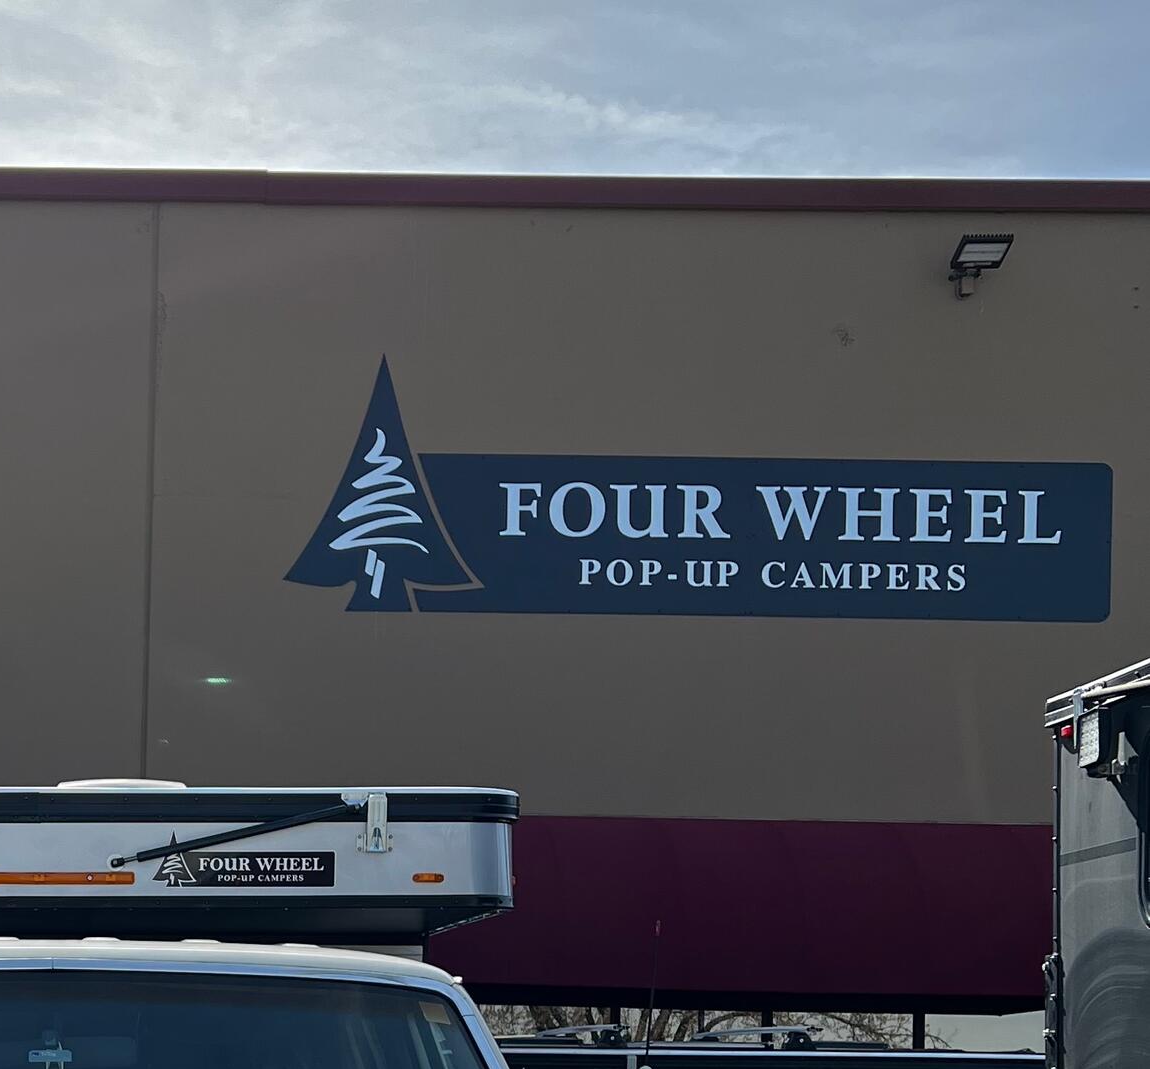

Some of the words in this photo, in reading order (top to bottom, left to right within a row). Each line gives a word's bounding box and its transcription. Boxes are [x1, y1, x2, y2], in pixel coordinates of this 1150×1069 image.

[499, 481, 731, 540] FOUR
[756, 485, 1062, 545] WHEEL
[579, 558, 739, 588] POP-UP
[761, 561, 968, 592] CAMPERS
[198, 857, 250, 872] FOUR
[255, 857, 324, 872] WHEEL
[217, 874, 255, 882] POP-UP
[257, 874, 304, 882] CAMPERS
